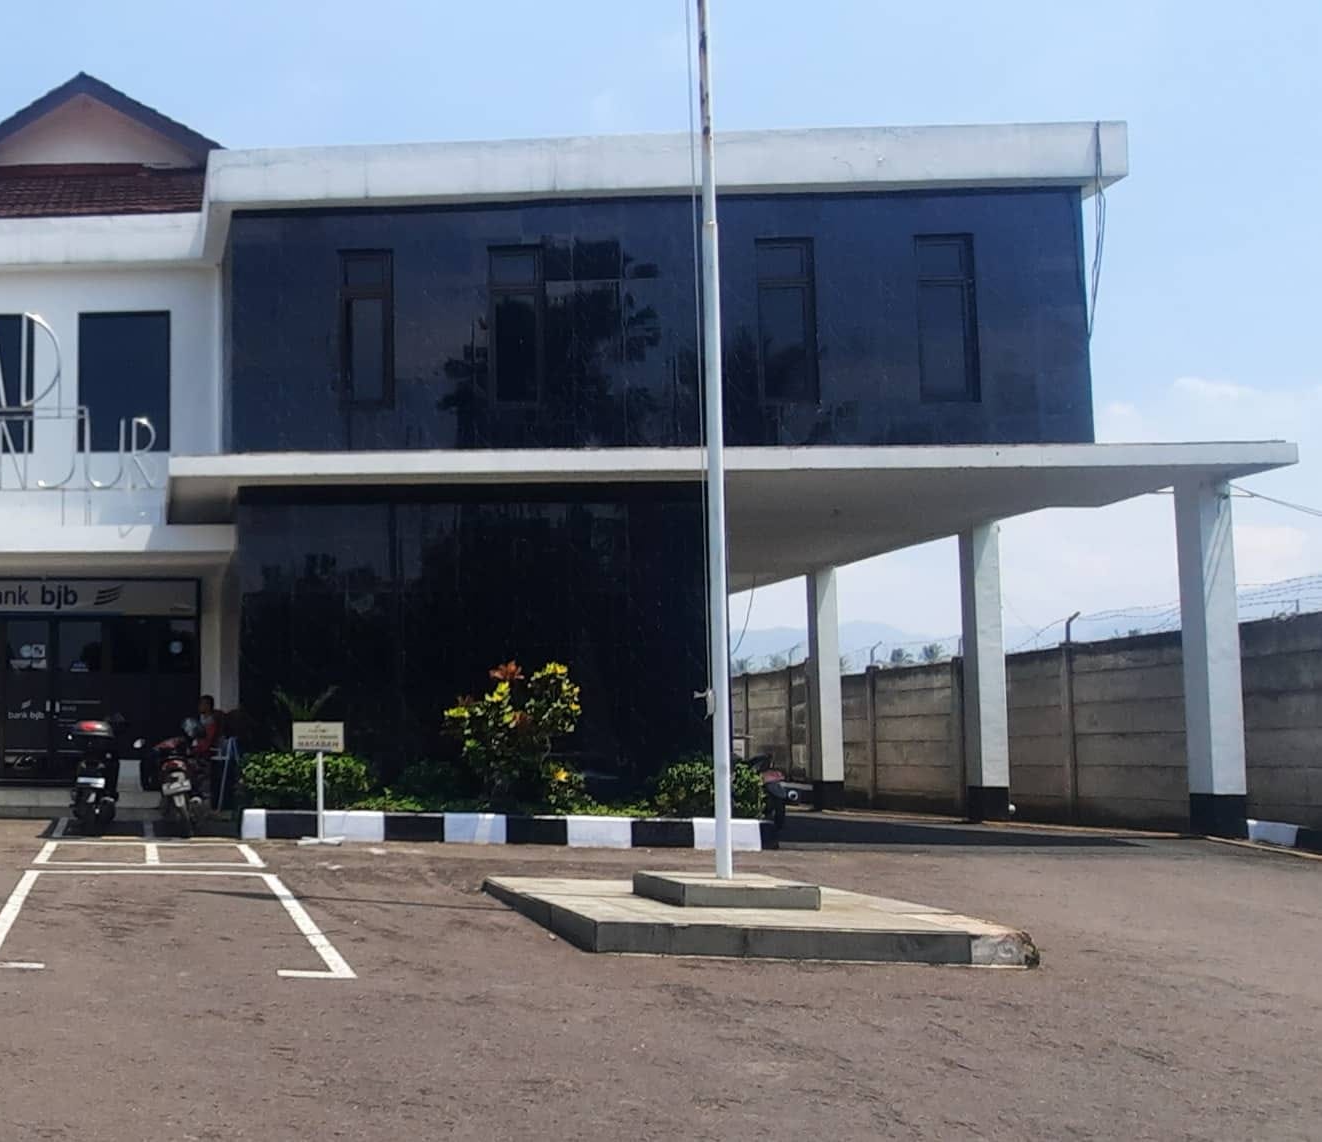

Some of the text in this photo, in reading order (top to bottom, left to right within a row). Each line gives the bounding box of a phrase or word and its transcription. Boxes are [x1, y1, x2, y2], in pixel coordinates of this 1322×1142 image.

[40, 583, 79, 610] bjb
[7, 711, 45, 721] bank bjb
